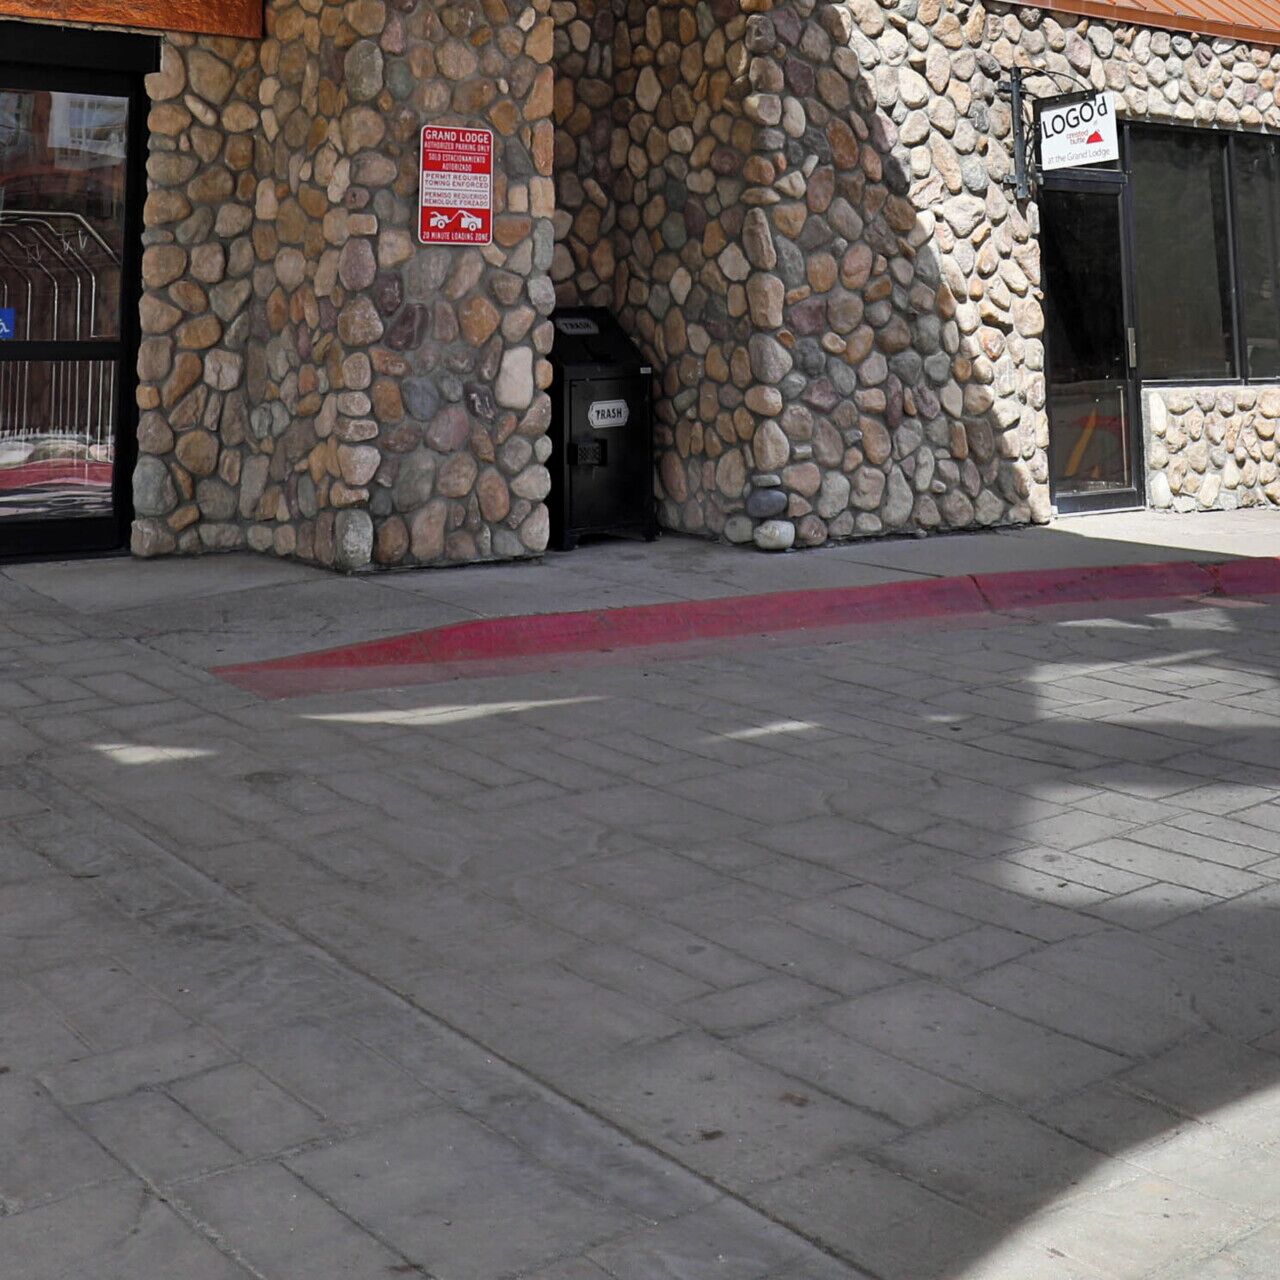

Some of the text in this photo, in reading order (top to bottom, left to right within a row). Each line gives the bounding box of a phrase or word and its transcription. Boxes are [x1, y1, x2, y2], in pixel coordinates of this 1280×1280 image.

[1042, 96, 1108, 139] LOGO'd
[425, 129, 489, 144] GRAND LODGE
[424, 141, 490, 153] AUTHORIZED PARKING ONLY
[428, 152, 441, 161] SOLO
[1067, 149, 1088, 161] Grand
[1088, 148, 1110, 158] Lodge
[442, 162, 472, 172] AUTORIZADO
[422, 231, 489, 241] 20 MINUTE LOADING ZONE
[595, 407, 623, 420] TRASH
